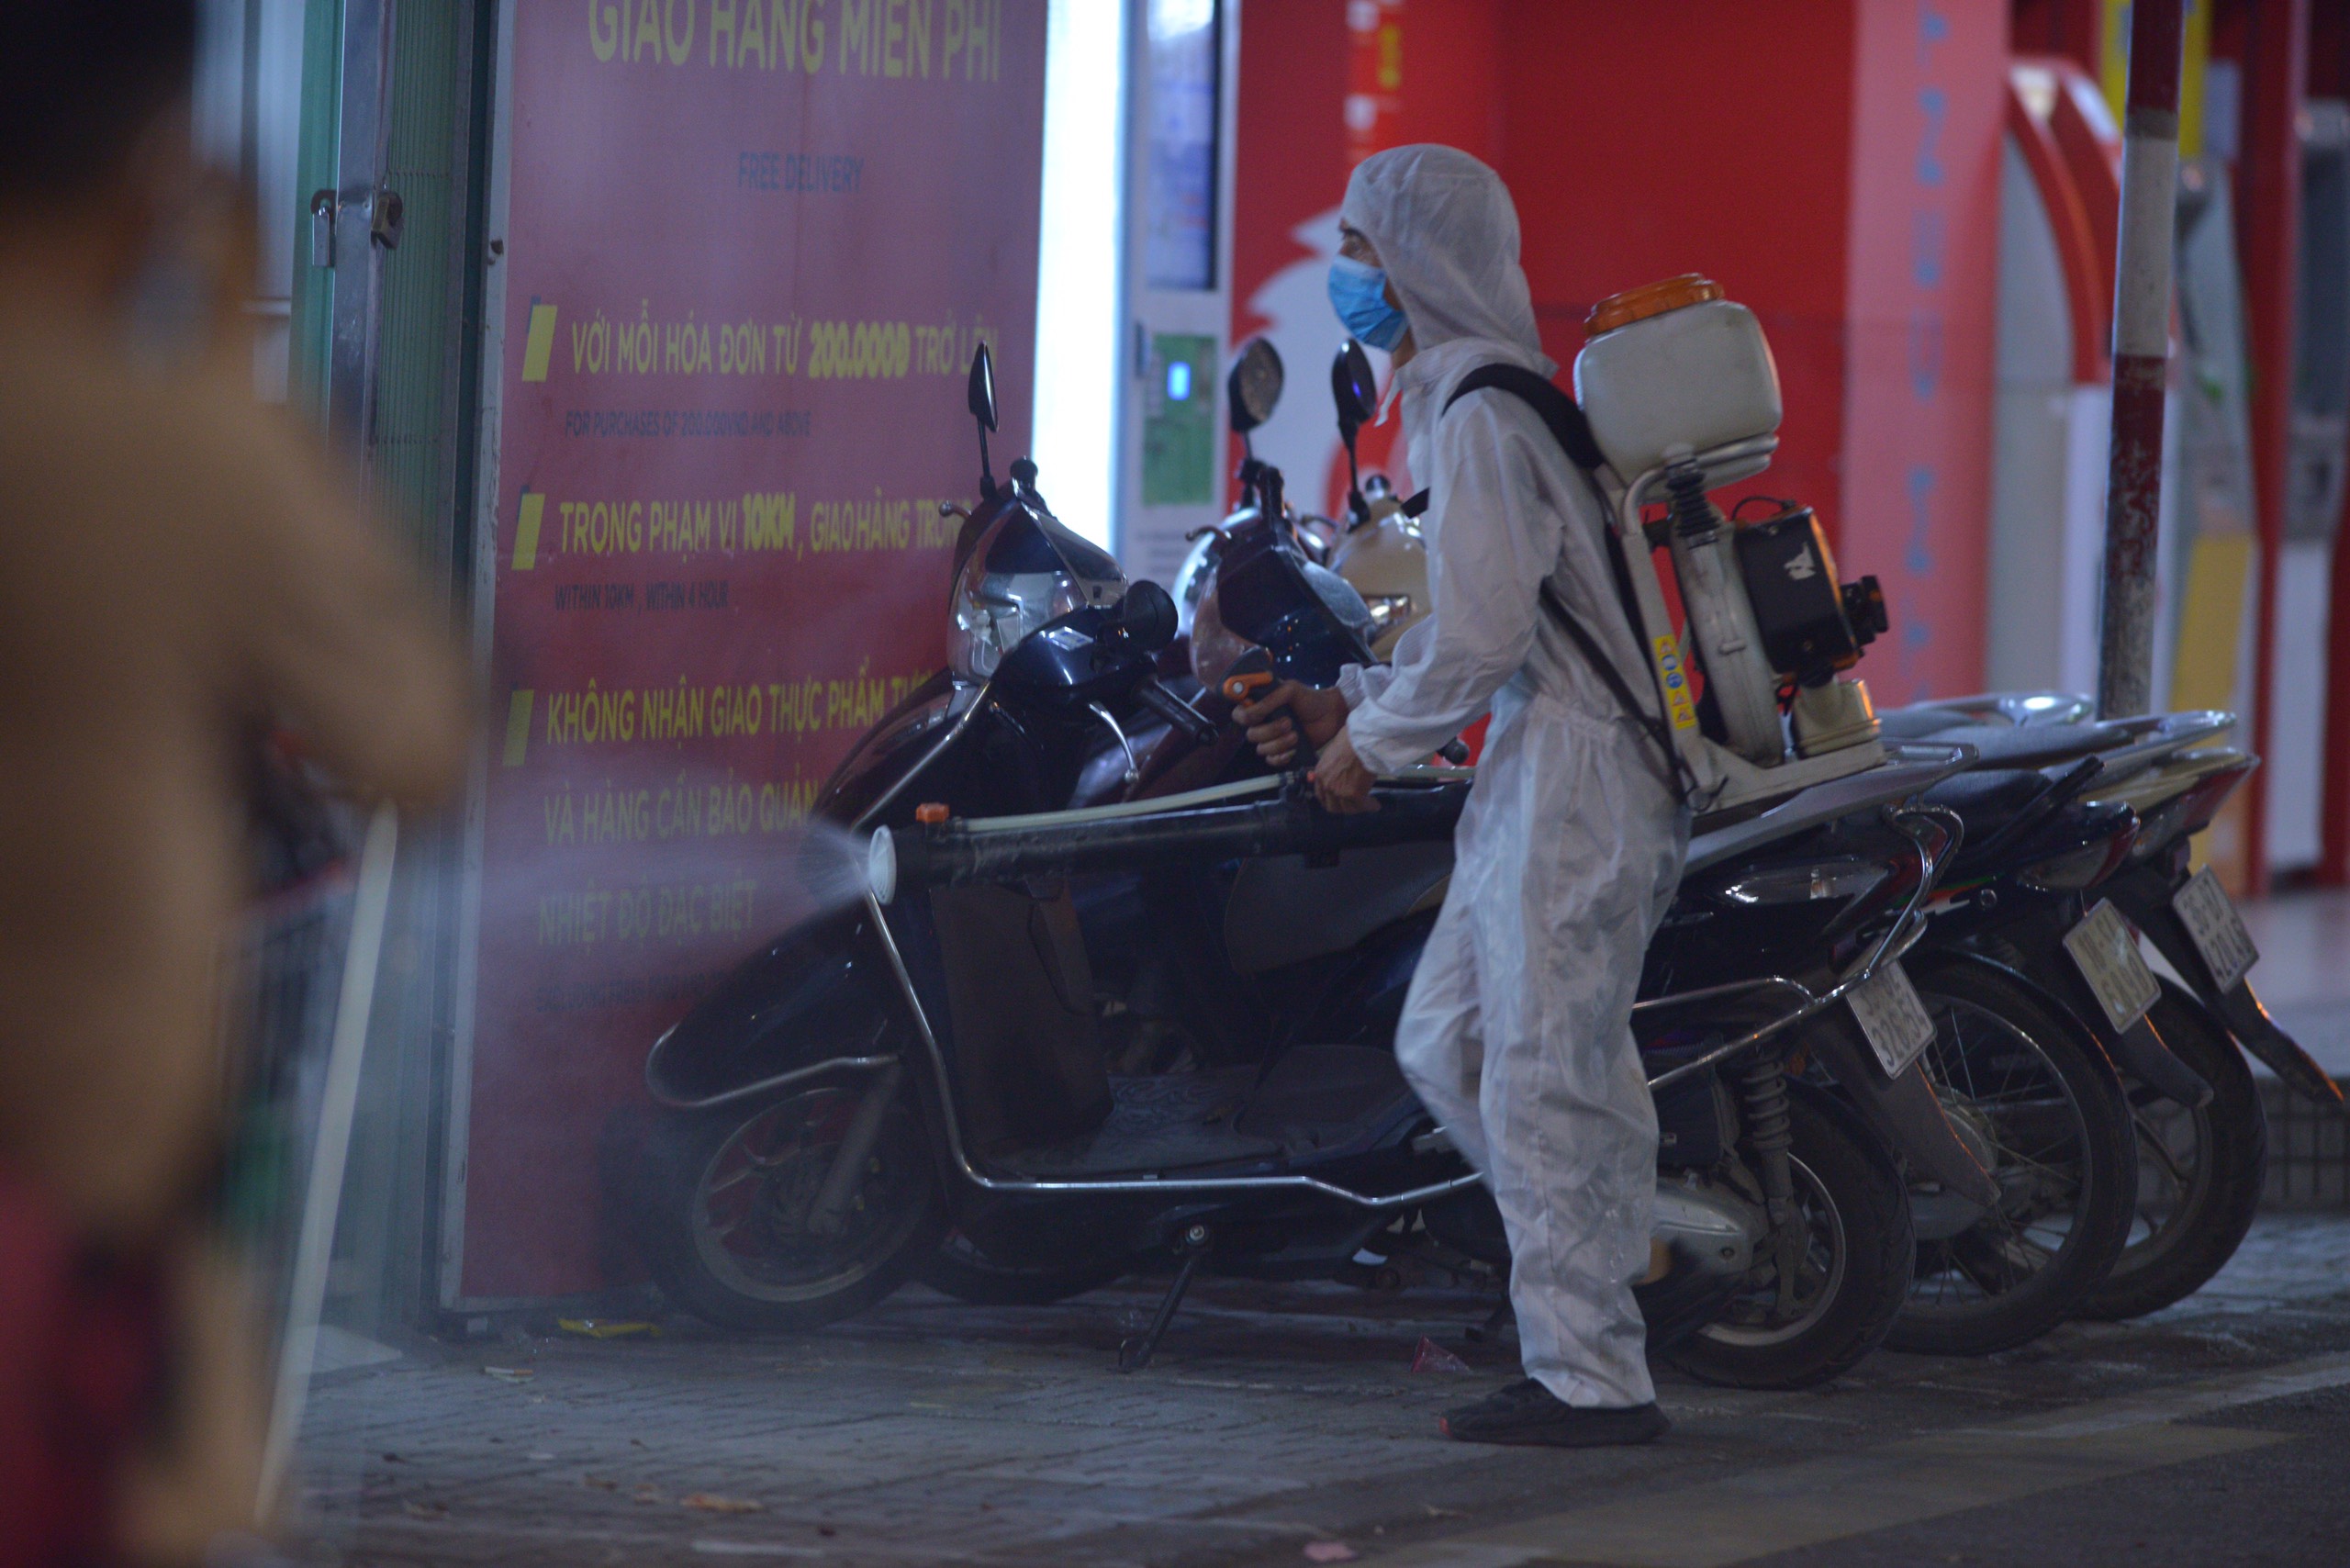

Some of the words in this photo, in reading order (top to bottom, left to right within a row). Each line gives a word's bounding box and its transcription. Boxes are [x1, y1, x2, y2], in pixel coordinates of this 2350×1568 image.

[588, 0, 696, 67] GIAO
[737, 151, 780, 192] FREE
[785, 153, 865, 195] DELIVERY
[572, 306, 611, 375] VỚI
[617, 298, 661, 375] MỖI
[666, 308, 713, 376] HÓA
[719, 315, 767, 377] ĐƠN
[773, 308, 804, 376] TỪ
[914, 308, 957, 375] TRỞ
[565, 409, 591, 439] FOR
[593, 410, 660, 439] PURCHASES
[662, 410, 679, 438] OF
[750, 410, 775, 438] AND
[778, 410, 811, 438] ABOVE
[559, 500, 643, 554] TRONG
[649, 498, 712, 565] PHẠM
[717, 499, 739, 553] VI
[554, 583, 602, 611] WITHIN
[645, 581, 686, 610] WITHIN
[688, 581, 696, 609] 4
[699, 579, 729, 610] HOUR
[545, 678, 636, 745] KHÔNG
[641, 673, 706, 751] NHẬN
[710, 683, 763, 738] GIAO
[768, 673, 824, 745] THỰC
[827, 654, 886, 731] PHẨM
[543, 780, 575, 846] VÀ
[582, 777, 652, 844] HÀNG
[707, 766, 753, 838] BẢO
[538, 876, 613, 956] NHIỆT
[618, 872, 653, 950] ĐỘ
[657, 875, 705, 948] ĐẶC
[711, 868, 758, 944] BIỆT
